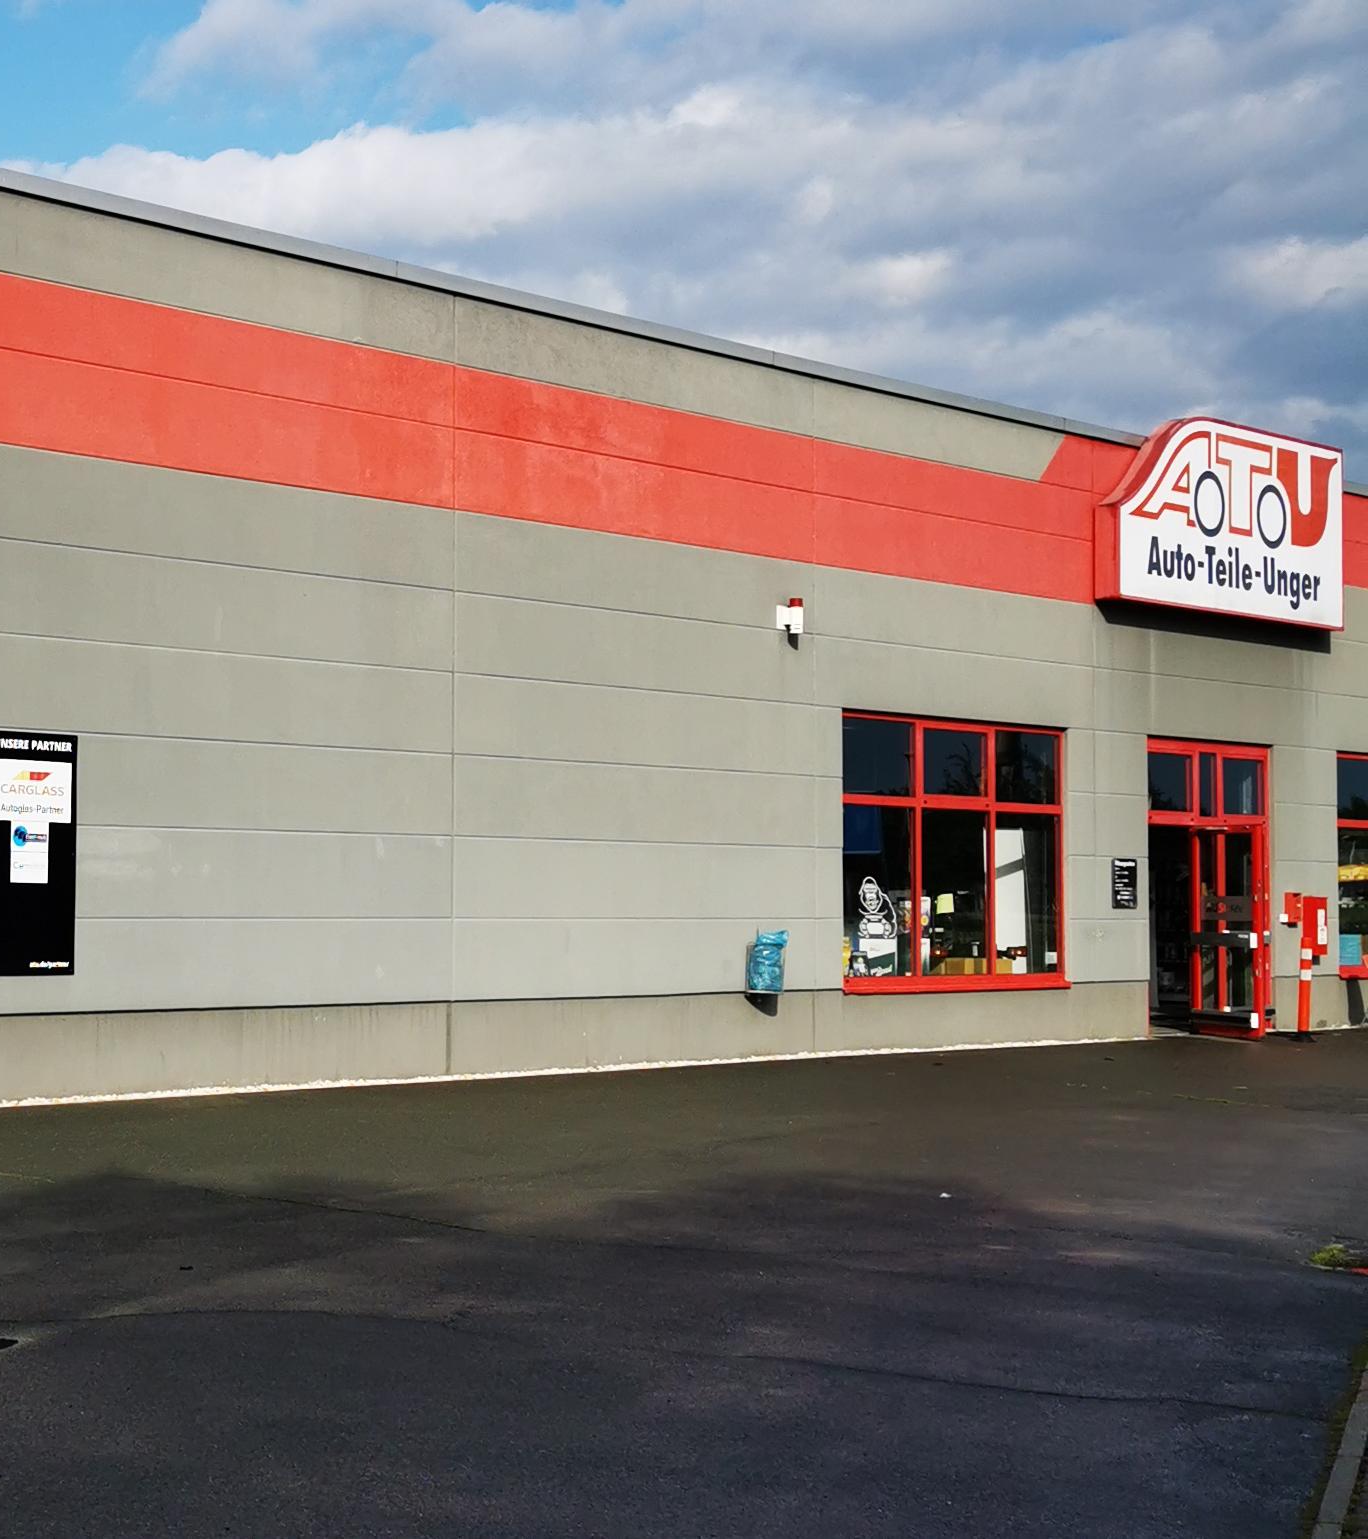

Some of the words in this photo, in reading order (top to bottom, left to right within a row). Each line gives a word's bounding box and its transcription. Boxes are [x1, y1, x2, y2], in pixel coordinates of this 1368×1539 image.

[1147, 536, 1320, 610] Auto-Teile-Unger
[31, 740, 72, 752] PARTNER
[0, 783, 64, 796] CARGLASS
